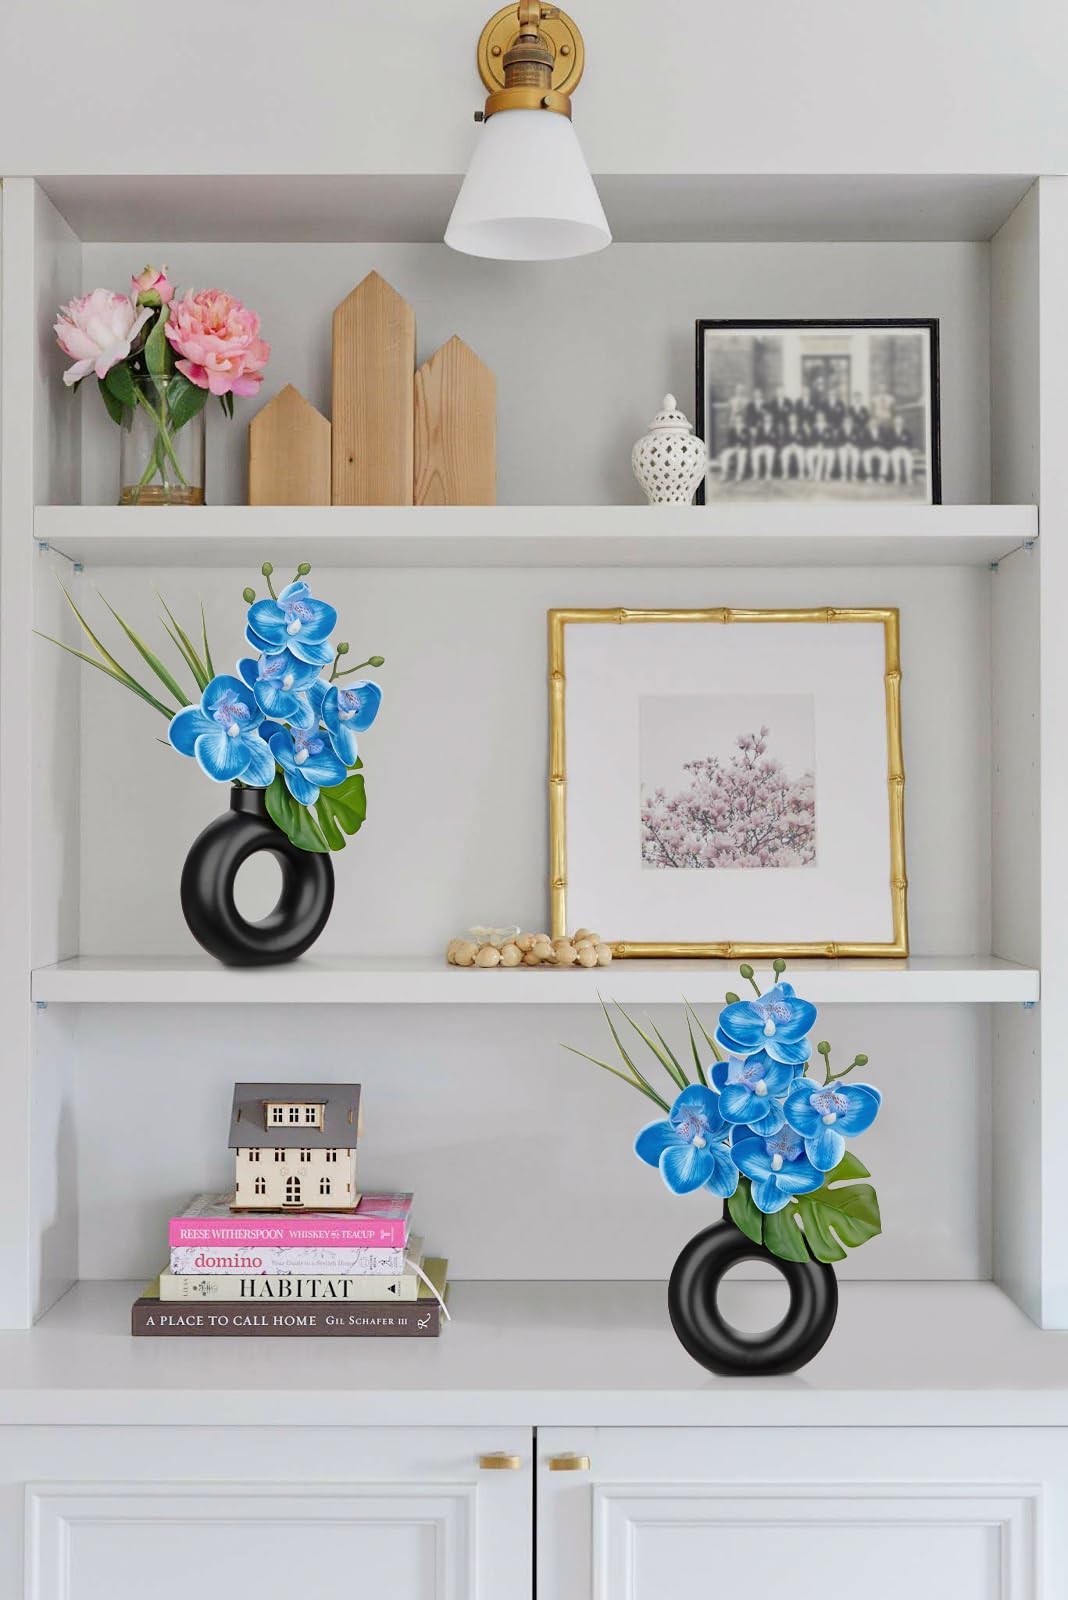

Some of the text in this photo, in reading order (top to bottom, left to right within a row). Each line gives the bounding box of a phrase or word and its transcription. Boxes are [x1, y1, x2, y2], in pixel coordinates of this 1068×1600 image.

[180, 1229, 283, 1239] REESE WITHERSPOON
[289, 1230, 330, 1239] WHISKEY
[341, 1230, 375, 1239] TEACUP
[195, 1253, 262, 1268] domino
[240, 1279, 354, 1298] HABITAT
[146, 1315, 317, 1326] A PLACE TO CALL HOME
[349, 1315, 395, 1326] SCHAFER
